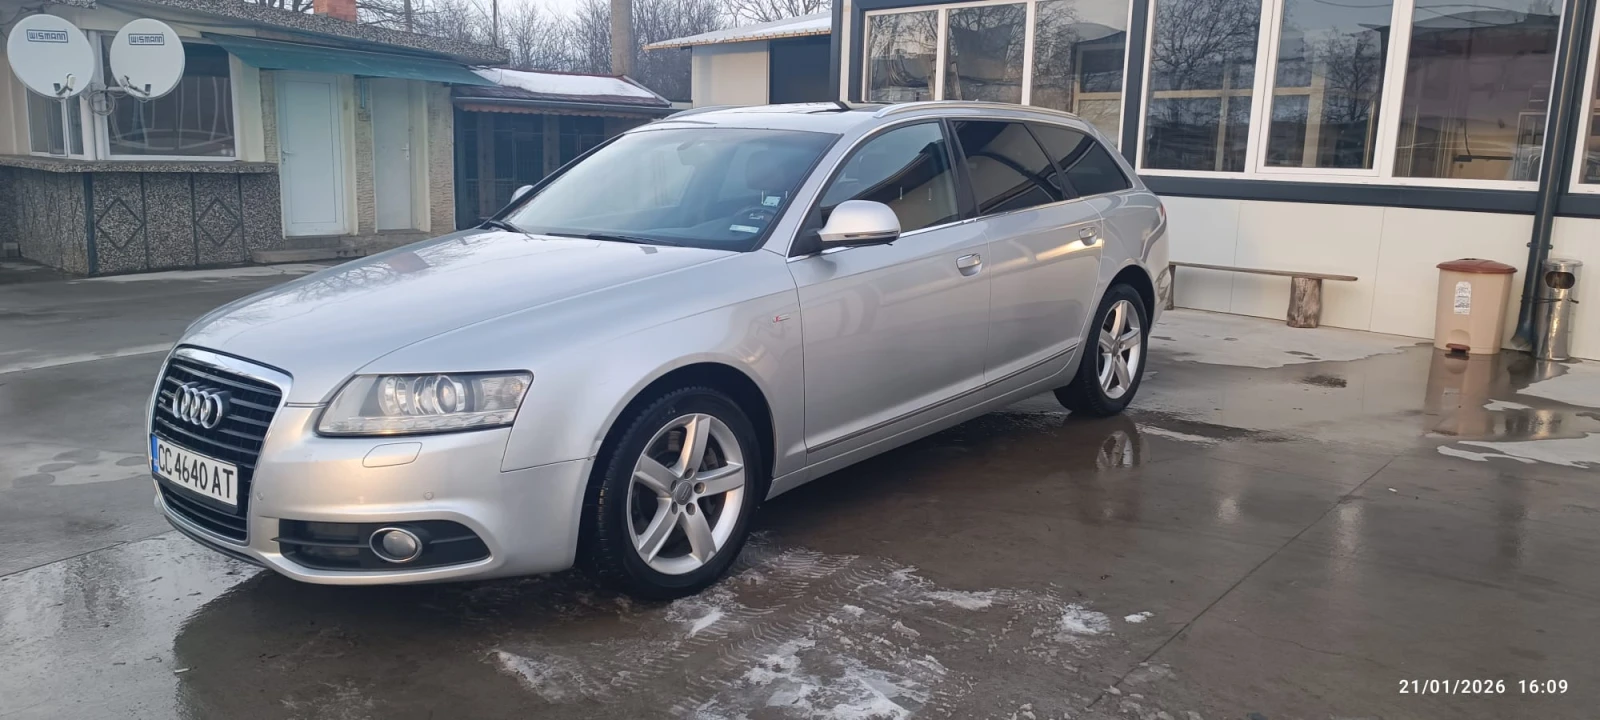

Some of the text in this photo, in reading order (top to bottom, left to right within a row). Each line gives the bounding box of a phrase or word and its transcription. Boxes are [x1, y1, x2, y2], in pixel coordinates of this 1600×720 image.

[159, 444, 234, 498] CC 4640 AT
